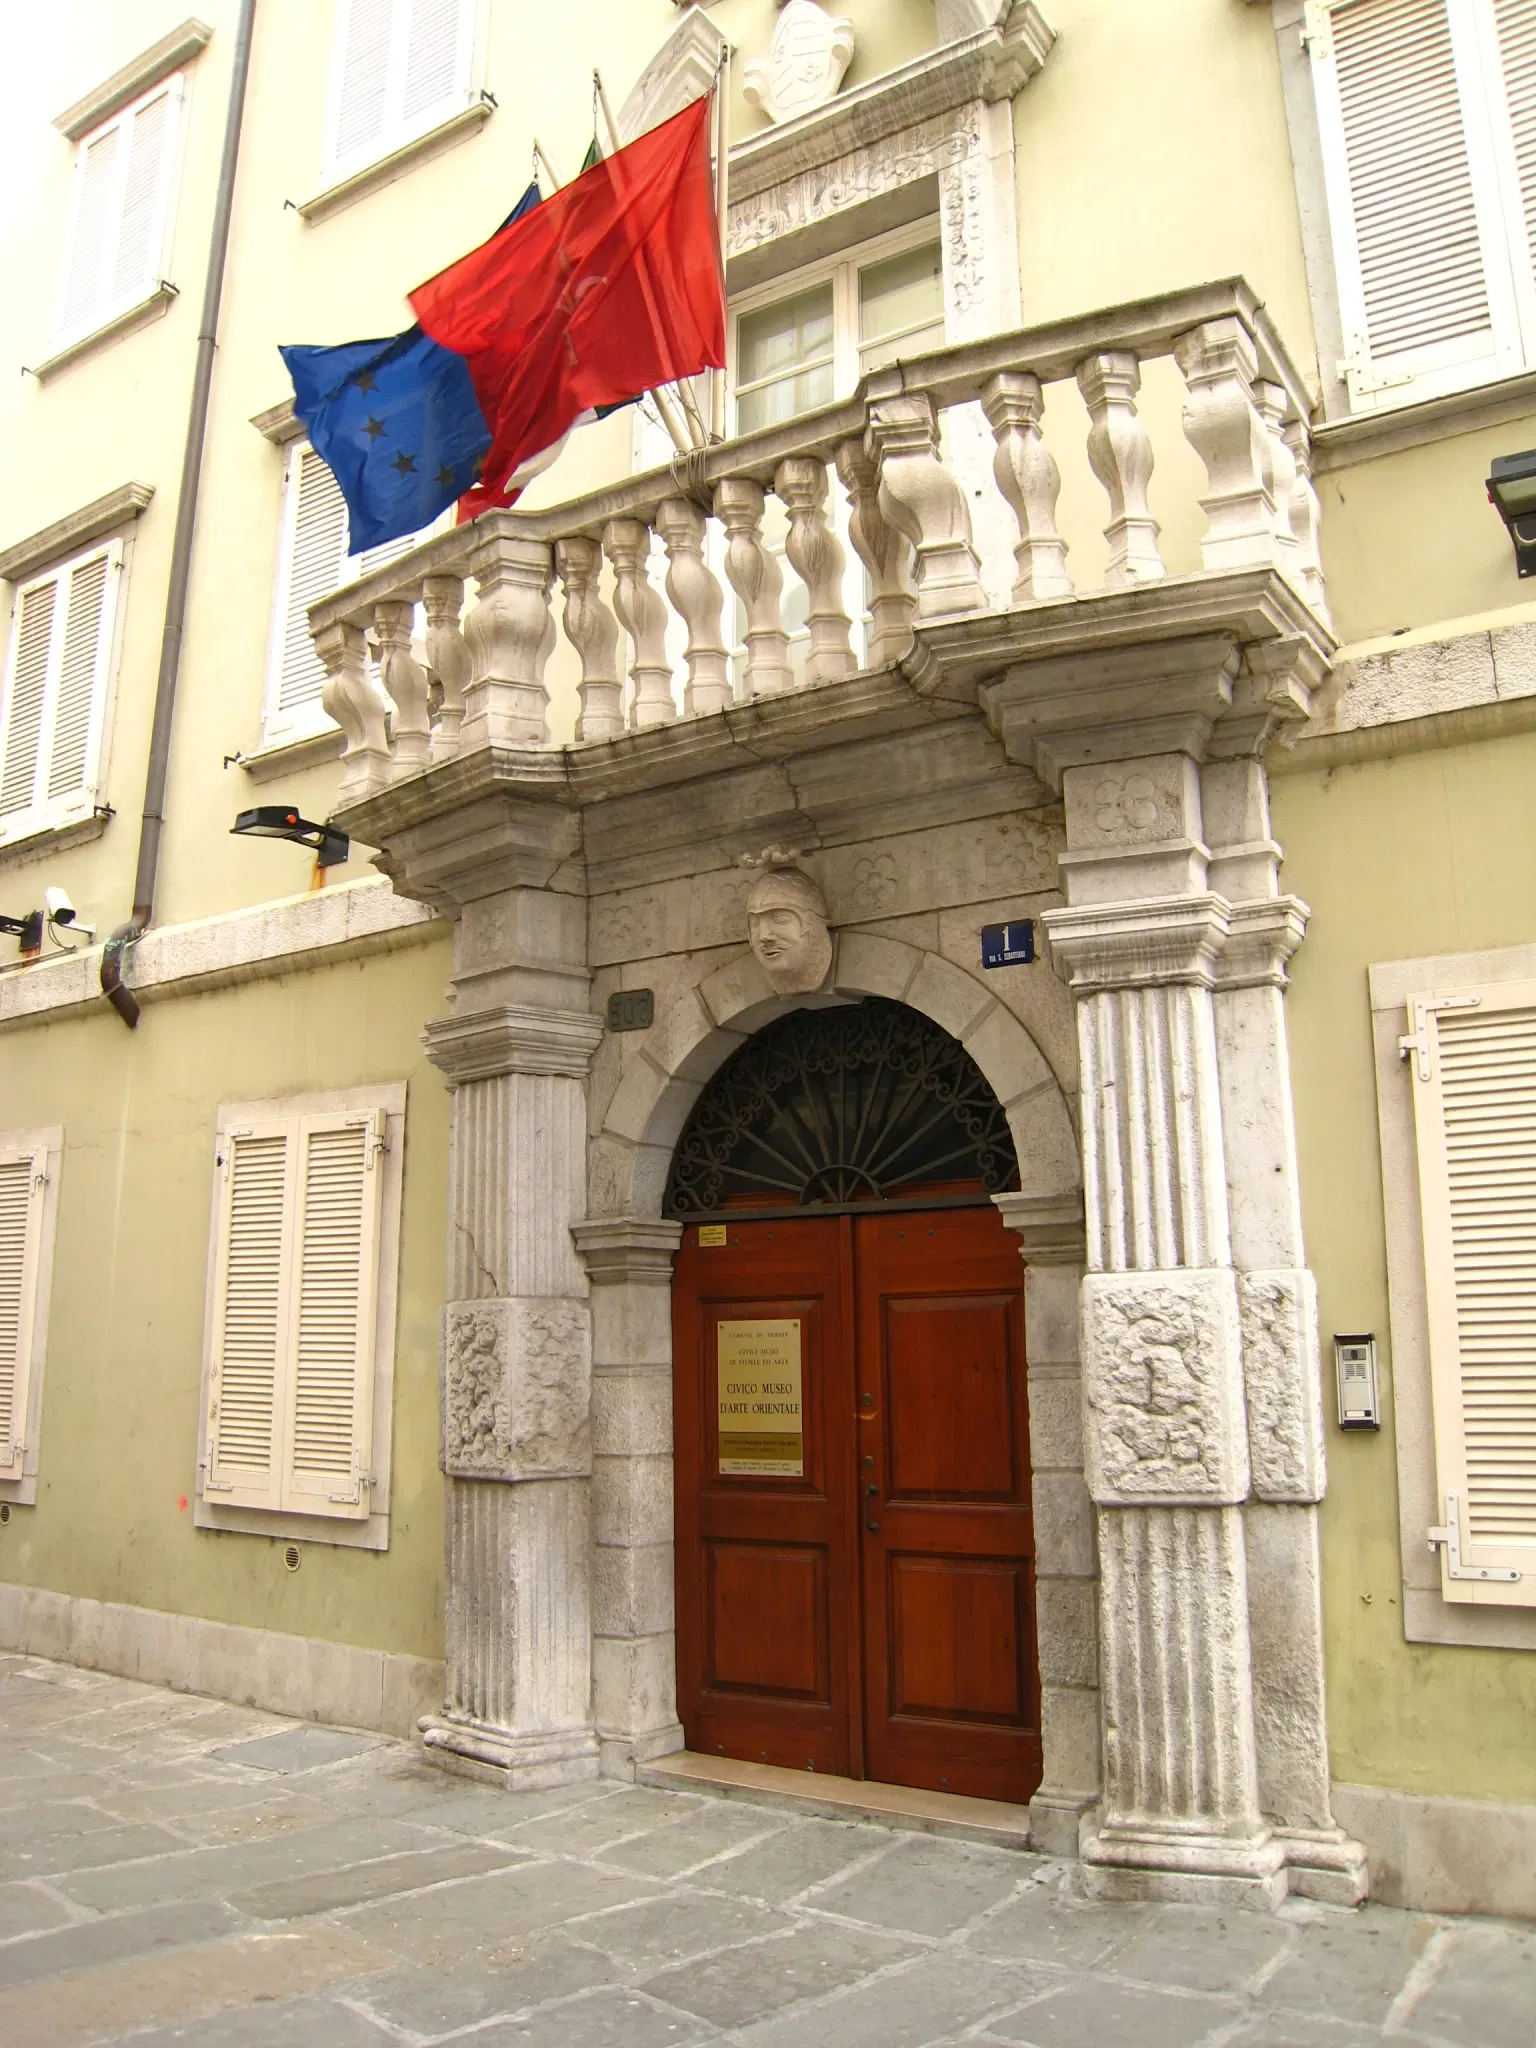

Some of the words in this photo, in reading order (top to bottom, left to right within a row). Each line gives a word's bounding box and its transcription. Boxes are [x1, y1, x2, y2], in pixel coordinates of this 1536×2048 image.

[1002, 926, 1010, 951] 1
[727, 1383, 758, 1394] CIVICO
[762, 1383, 792, 1394] MUSEO
[720, 1403, 748, 1414] D'ARTE
[752, 1403, 800, 1414] ORIENTALE
